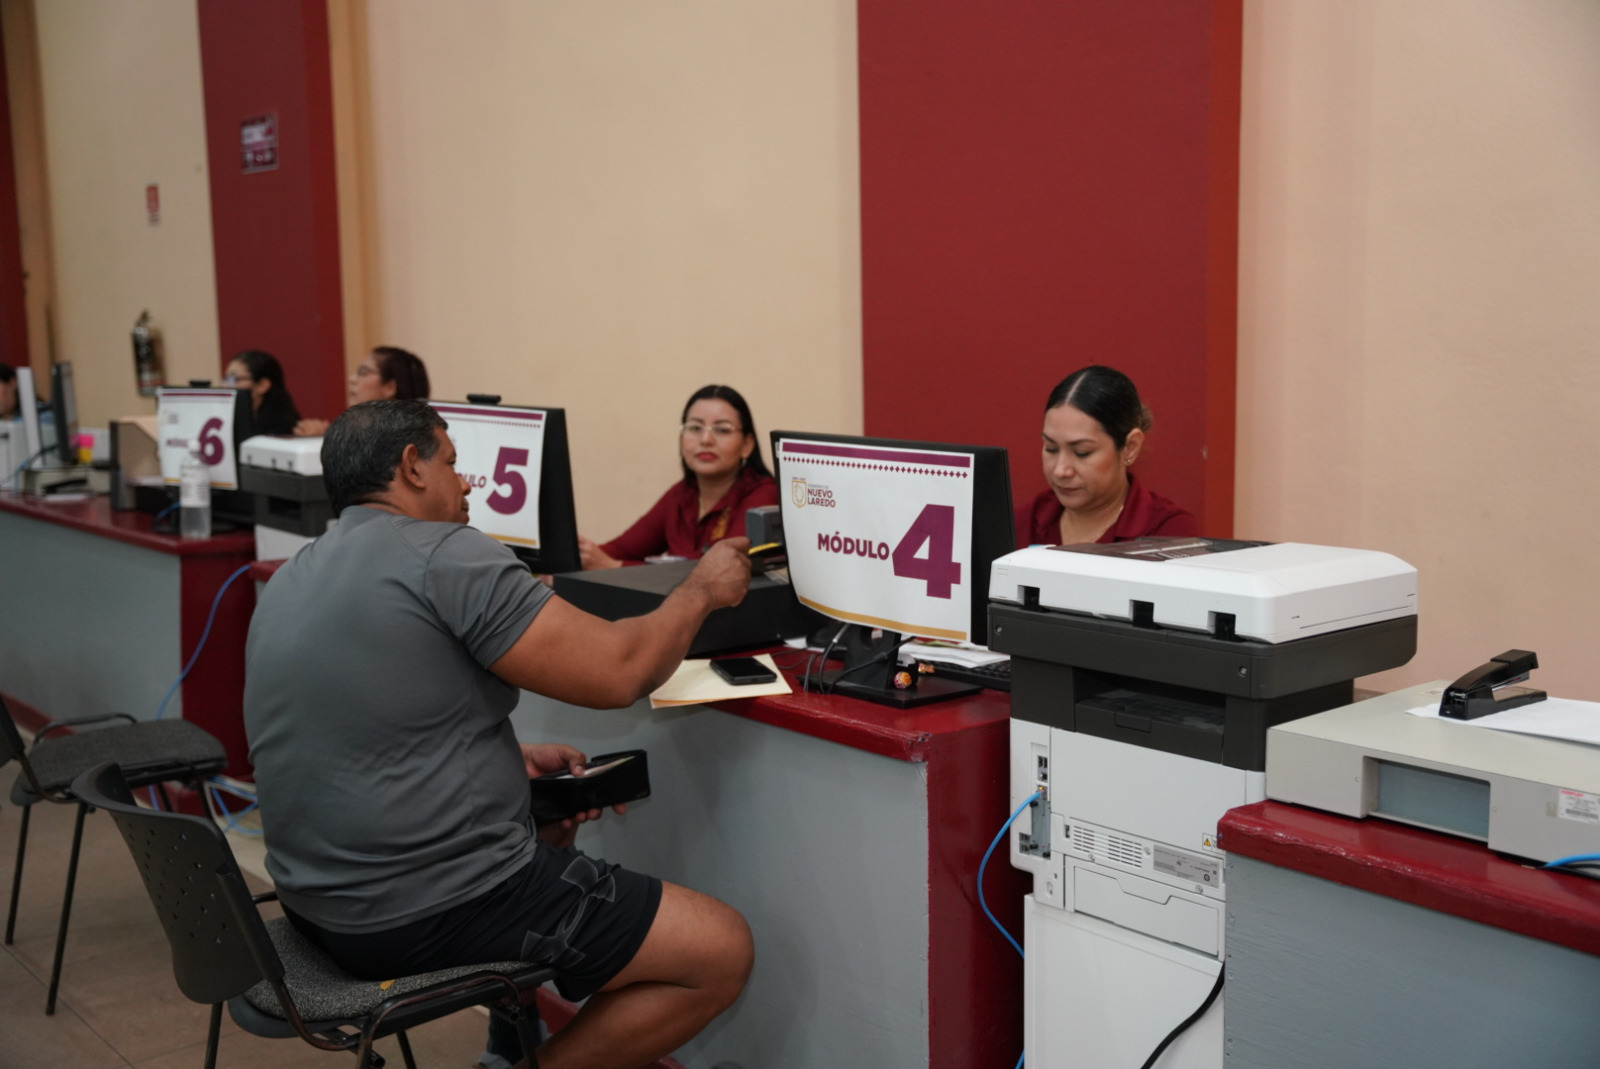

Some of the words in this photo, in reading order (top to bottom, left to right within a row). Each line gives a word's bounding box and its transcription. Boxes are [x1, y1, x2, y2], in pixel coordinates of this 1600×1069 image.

[198, 417, 224, 466] 6
[486, 446, 529, 516] 5
[807, 488, 833, 499] NUEVO
[807, 497, 836, 508] LAREDO
[817, 531, 890, 561] MÓDULO
[892, 503, 962, 600] 4
